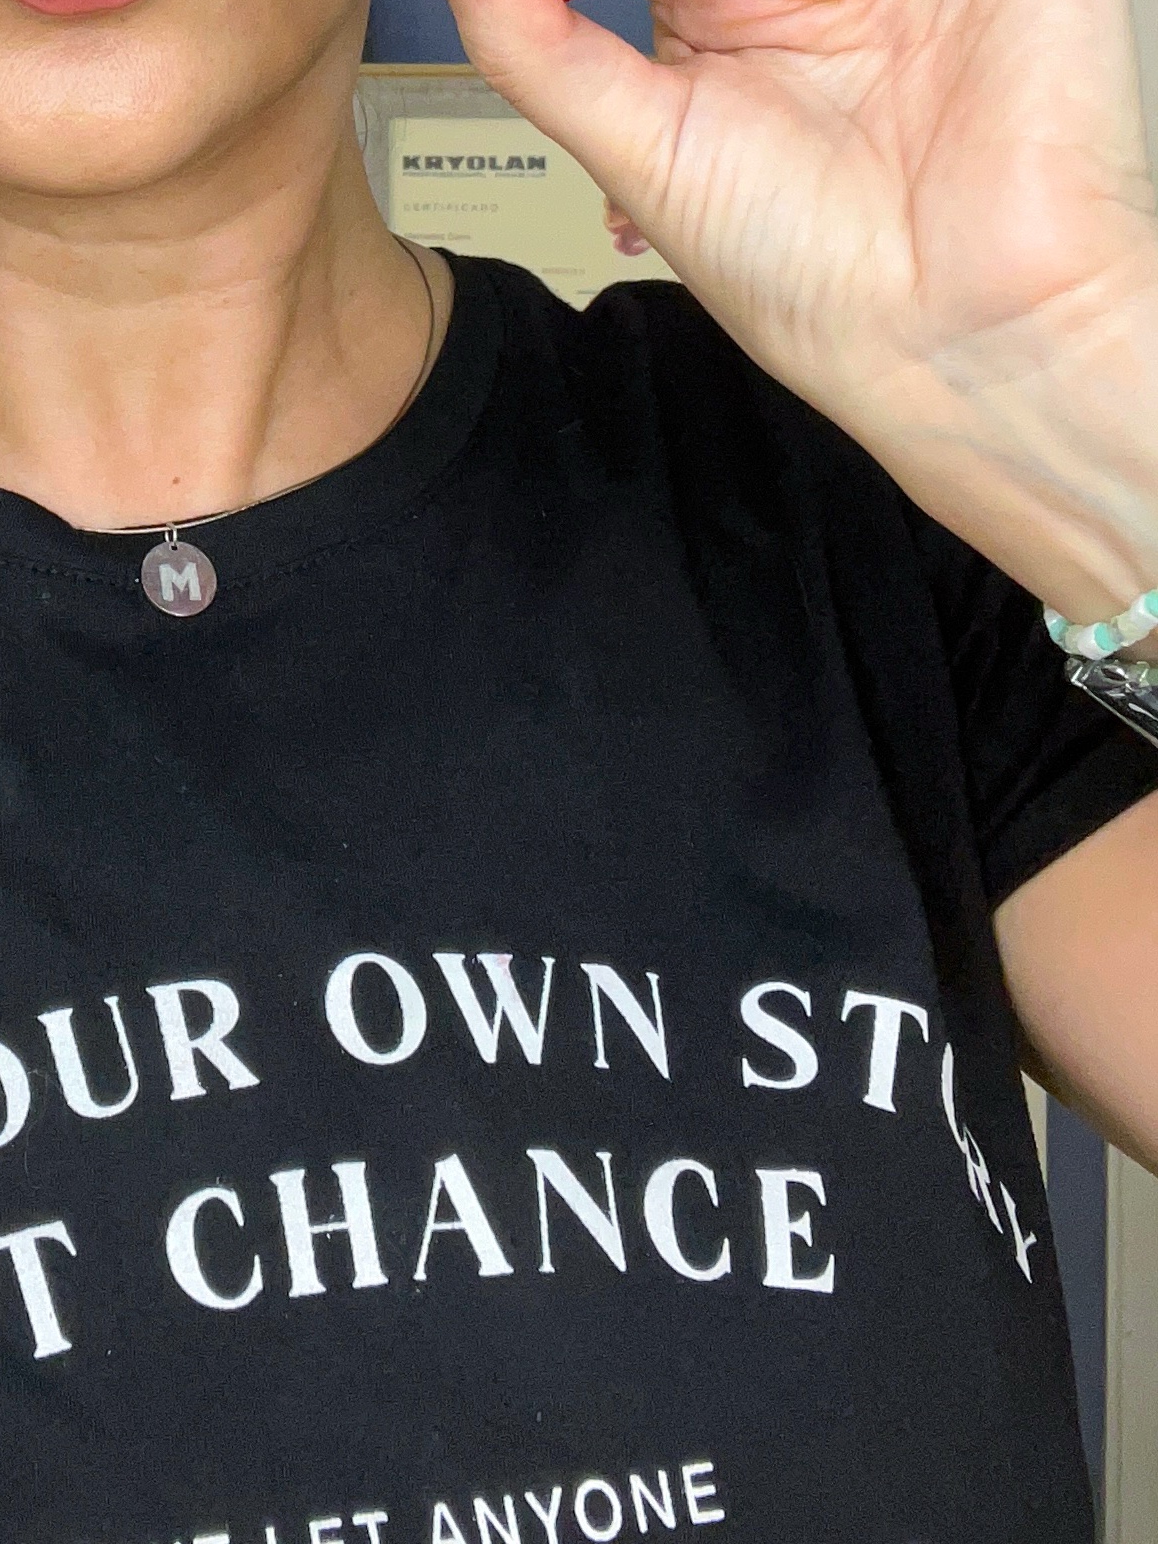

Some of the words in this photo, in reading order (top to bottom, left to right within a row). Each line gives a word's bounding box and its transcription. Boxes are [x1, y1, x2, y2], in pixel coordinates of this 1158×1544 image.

[402, 155, 546, 171] KRYOLAN
[158, 561, 202, 602] M
[325, 953, 670, 1079] OWN
[166, 1149, 834, 1310] CHANCE
[432, 1460, 726, 1544] ANYONE
